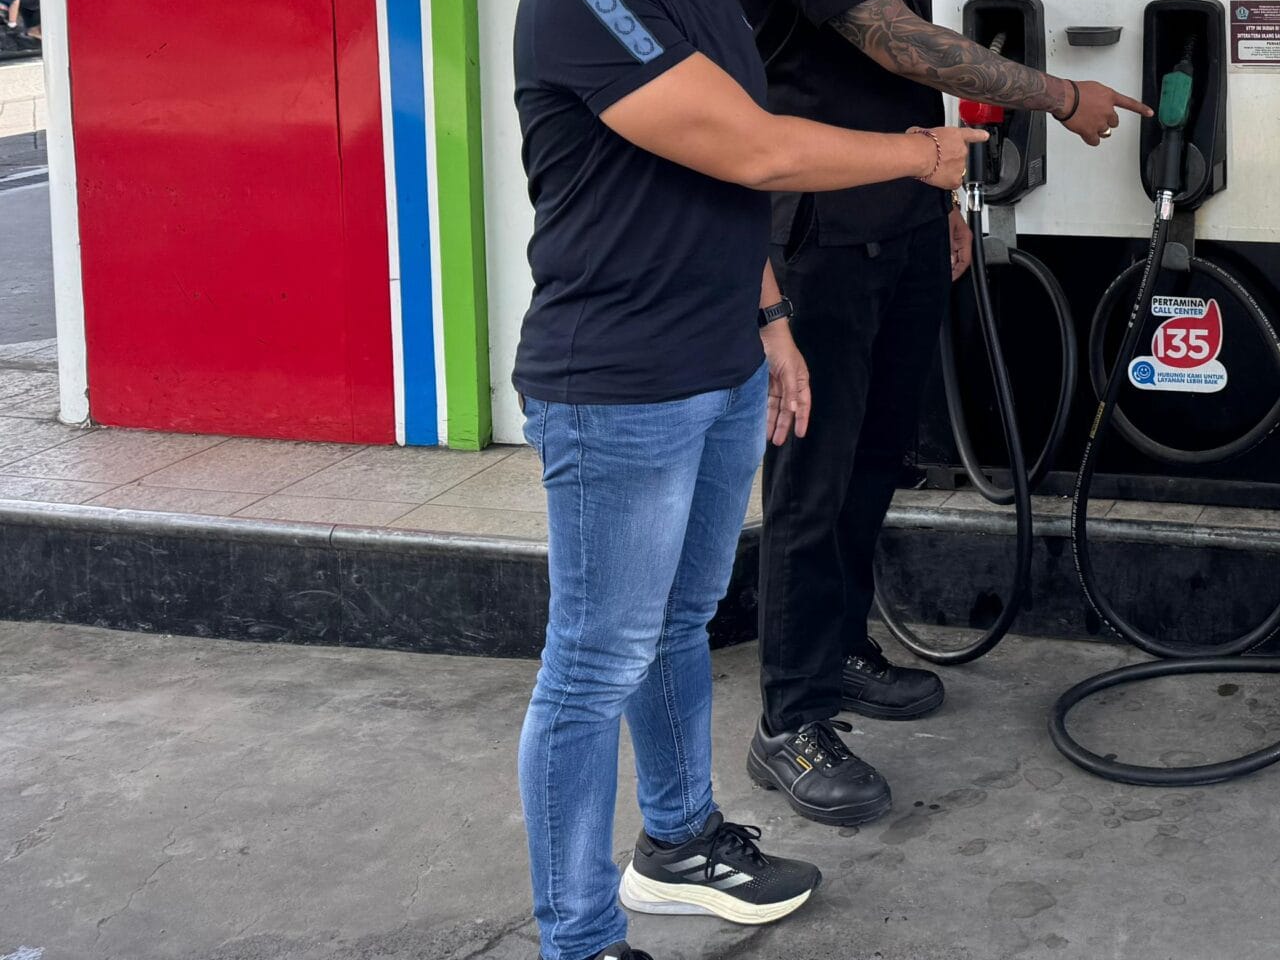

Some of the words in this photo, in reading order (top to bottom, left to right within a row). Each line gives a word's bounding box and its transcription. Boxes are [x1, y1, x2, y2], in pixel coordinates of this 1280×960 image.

[1153, 298, 1204, 307] PERTAMINA
[1153, 306, 1171, 314] CALL
[1174, 307, 1203, 315] CENTER
[1155, 327, 1210, 359] 135
